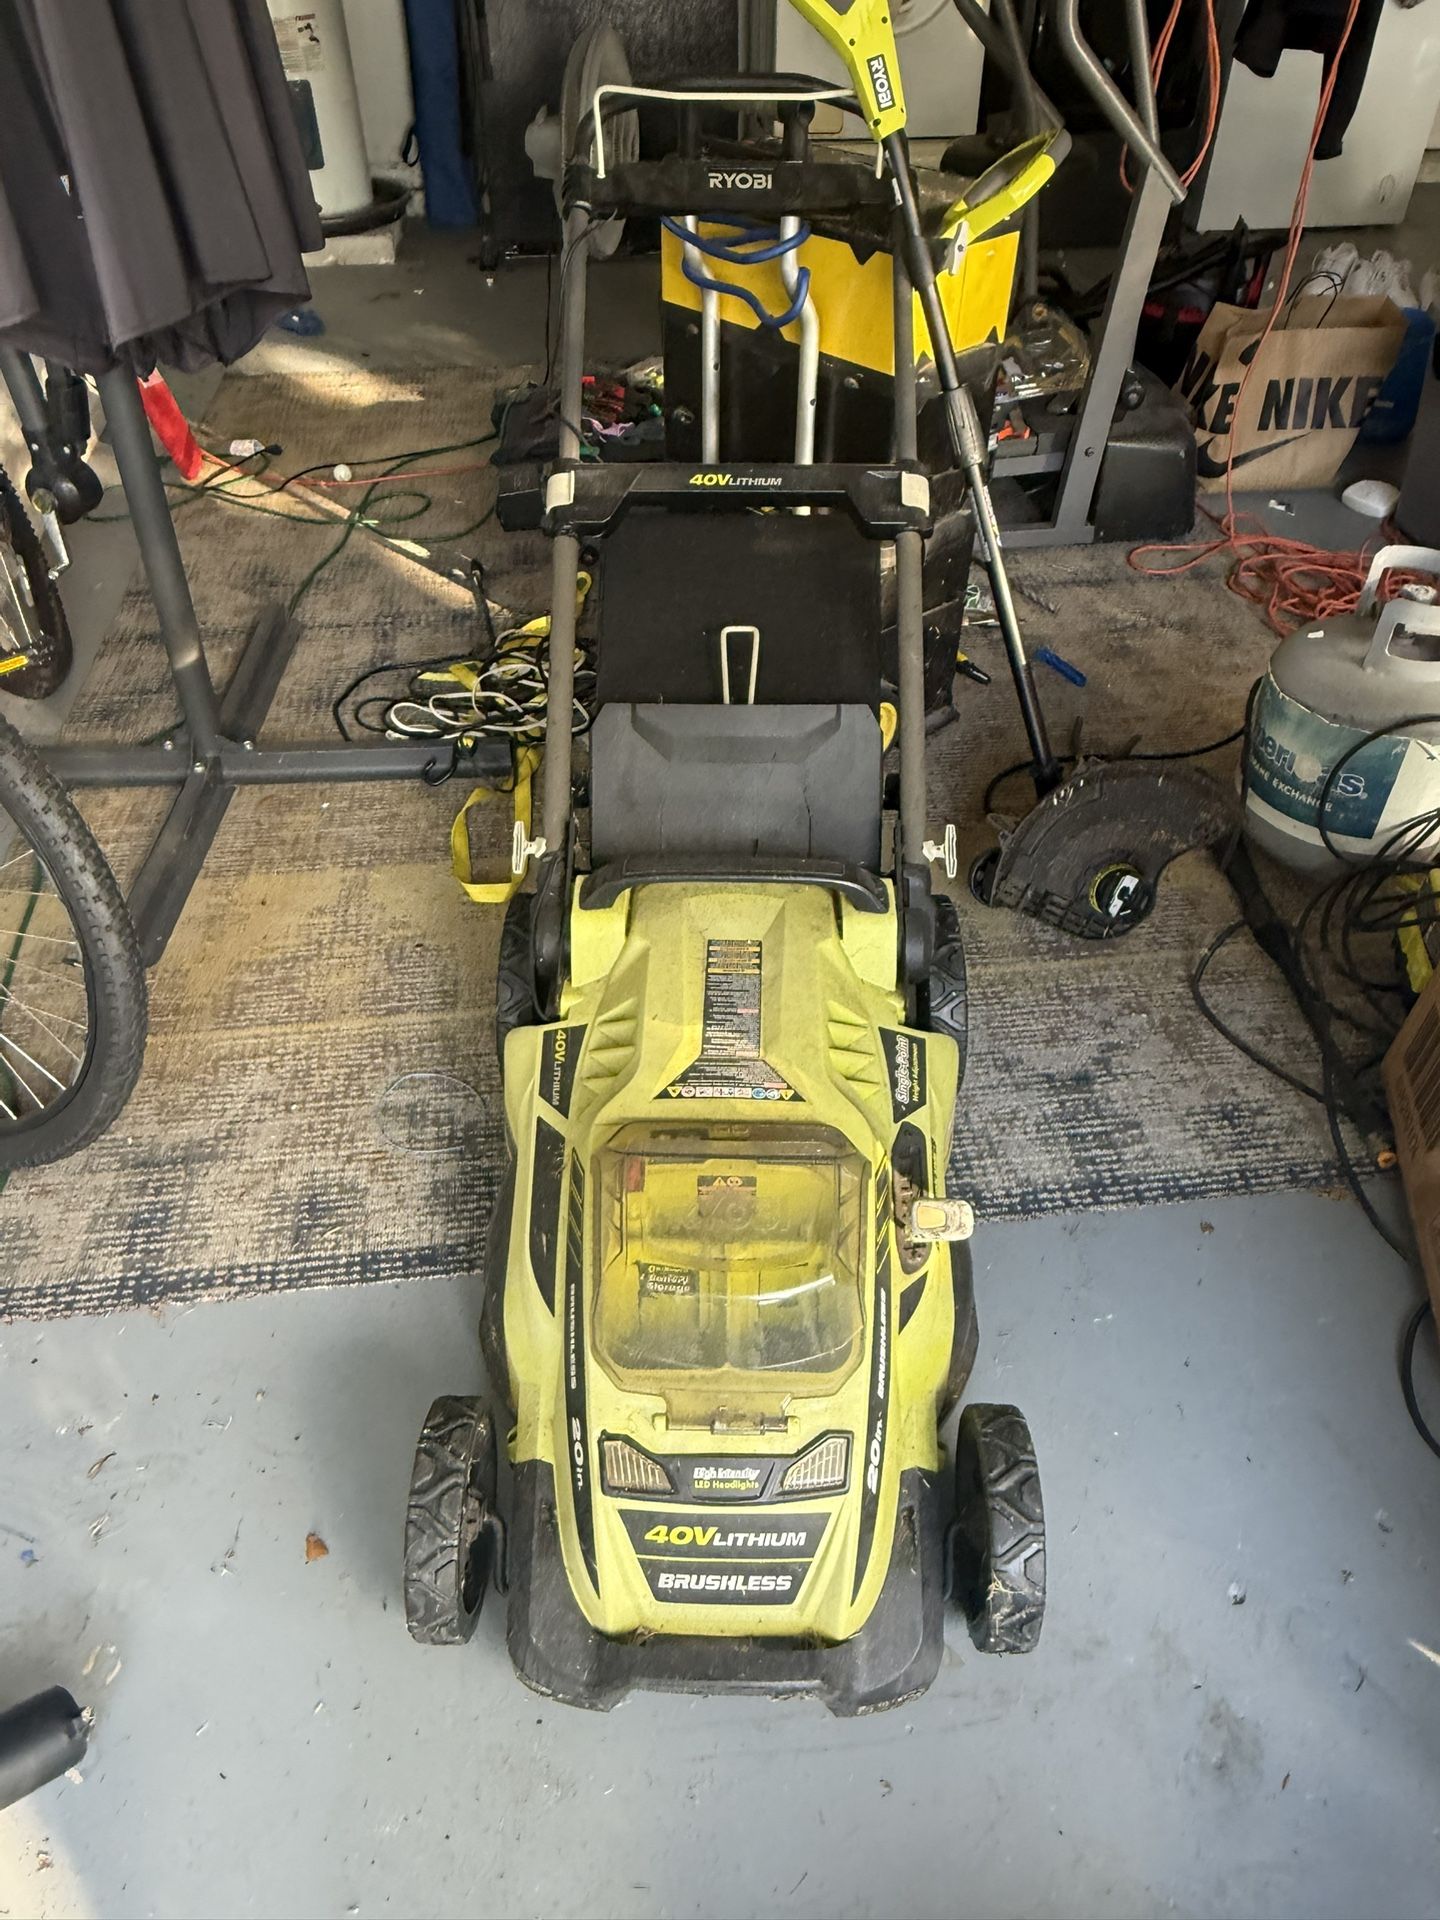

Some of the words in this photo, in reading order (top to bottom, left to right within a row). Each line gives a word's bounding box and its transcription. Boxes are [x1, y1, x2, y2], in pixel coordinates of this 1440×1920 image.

[869, 56, 893, 109] RYOBI
[708, 172, 773, 189] RYOBI
[1257, 376, 1385, 431] NIKE
[694, 1479, 711, 1489] LED
[712, 1479, 760, 1491] Headlights
[657, 1572, 793, 1592] BRUSHLESS
